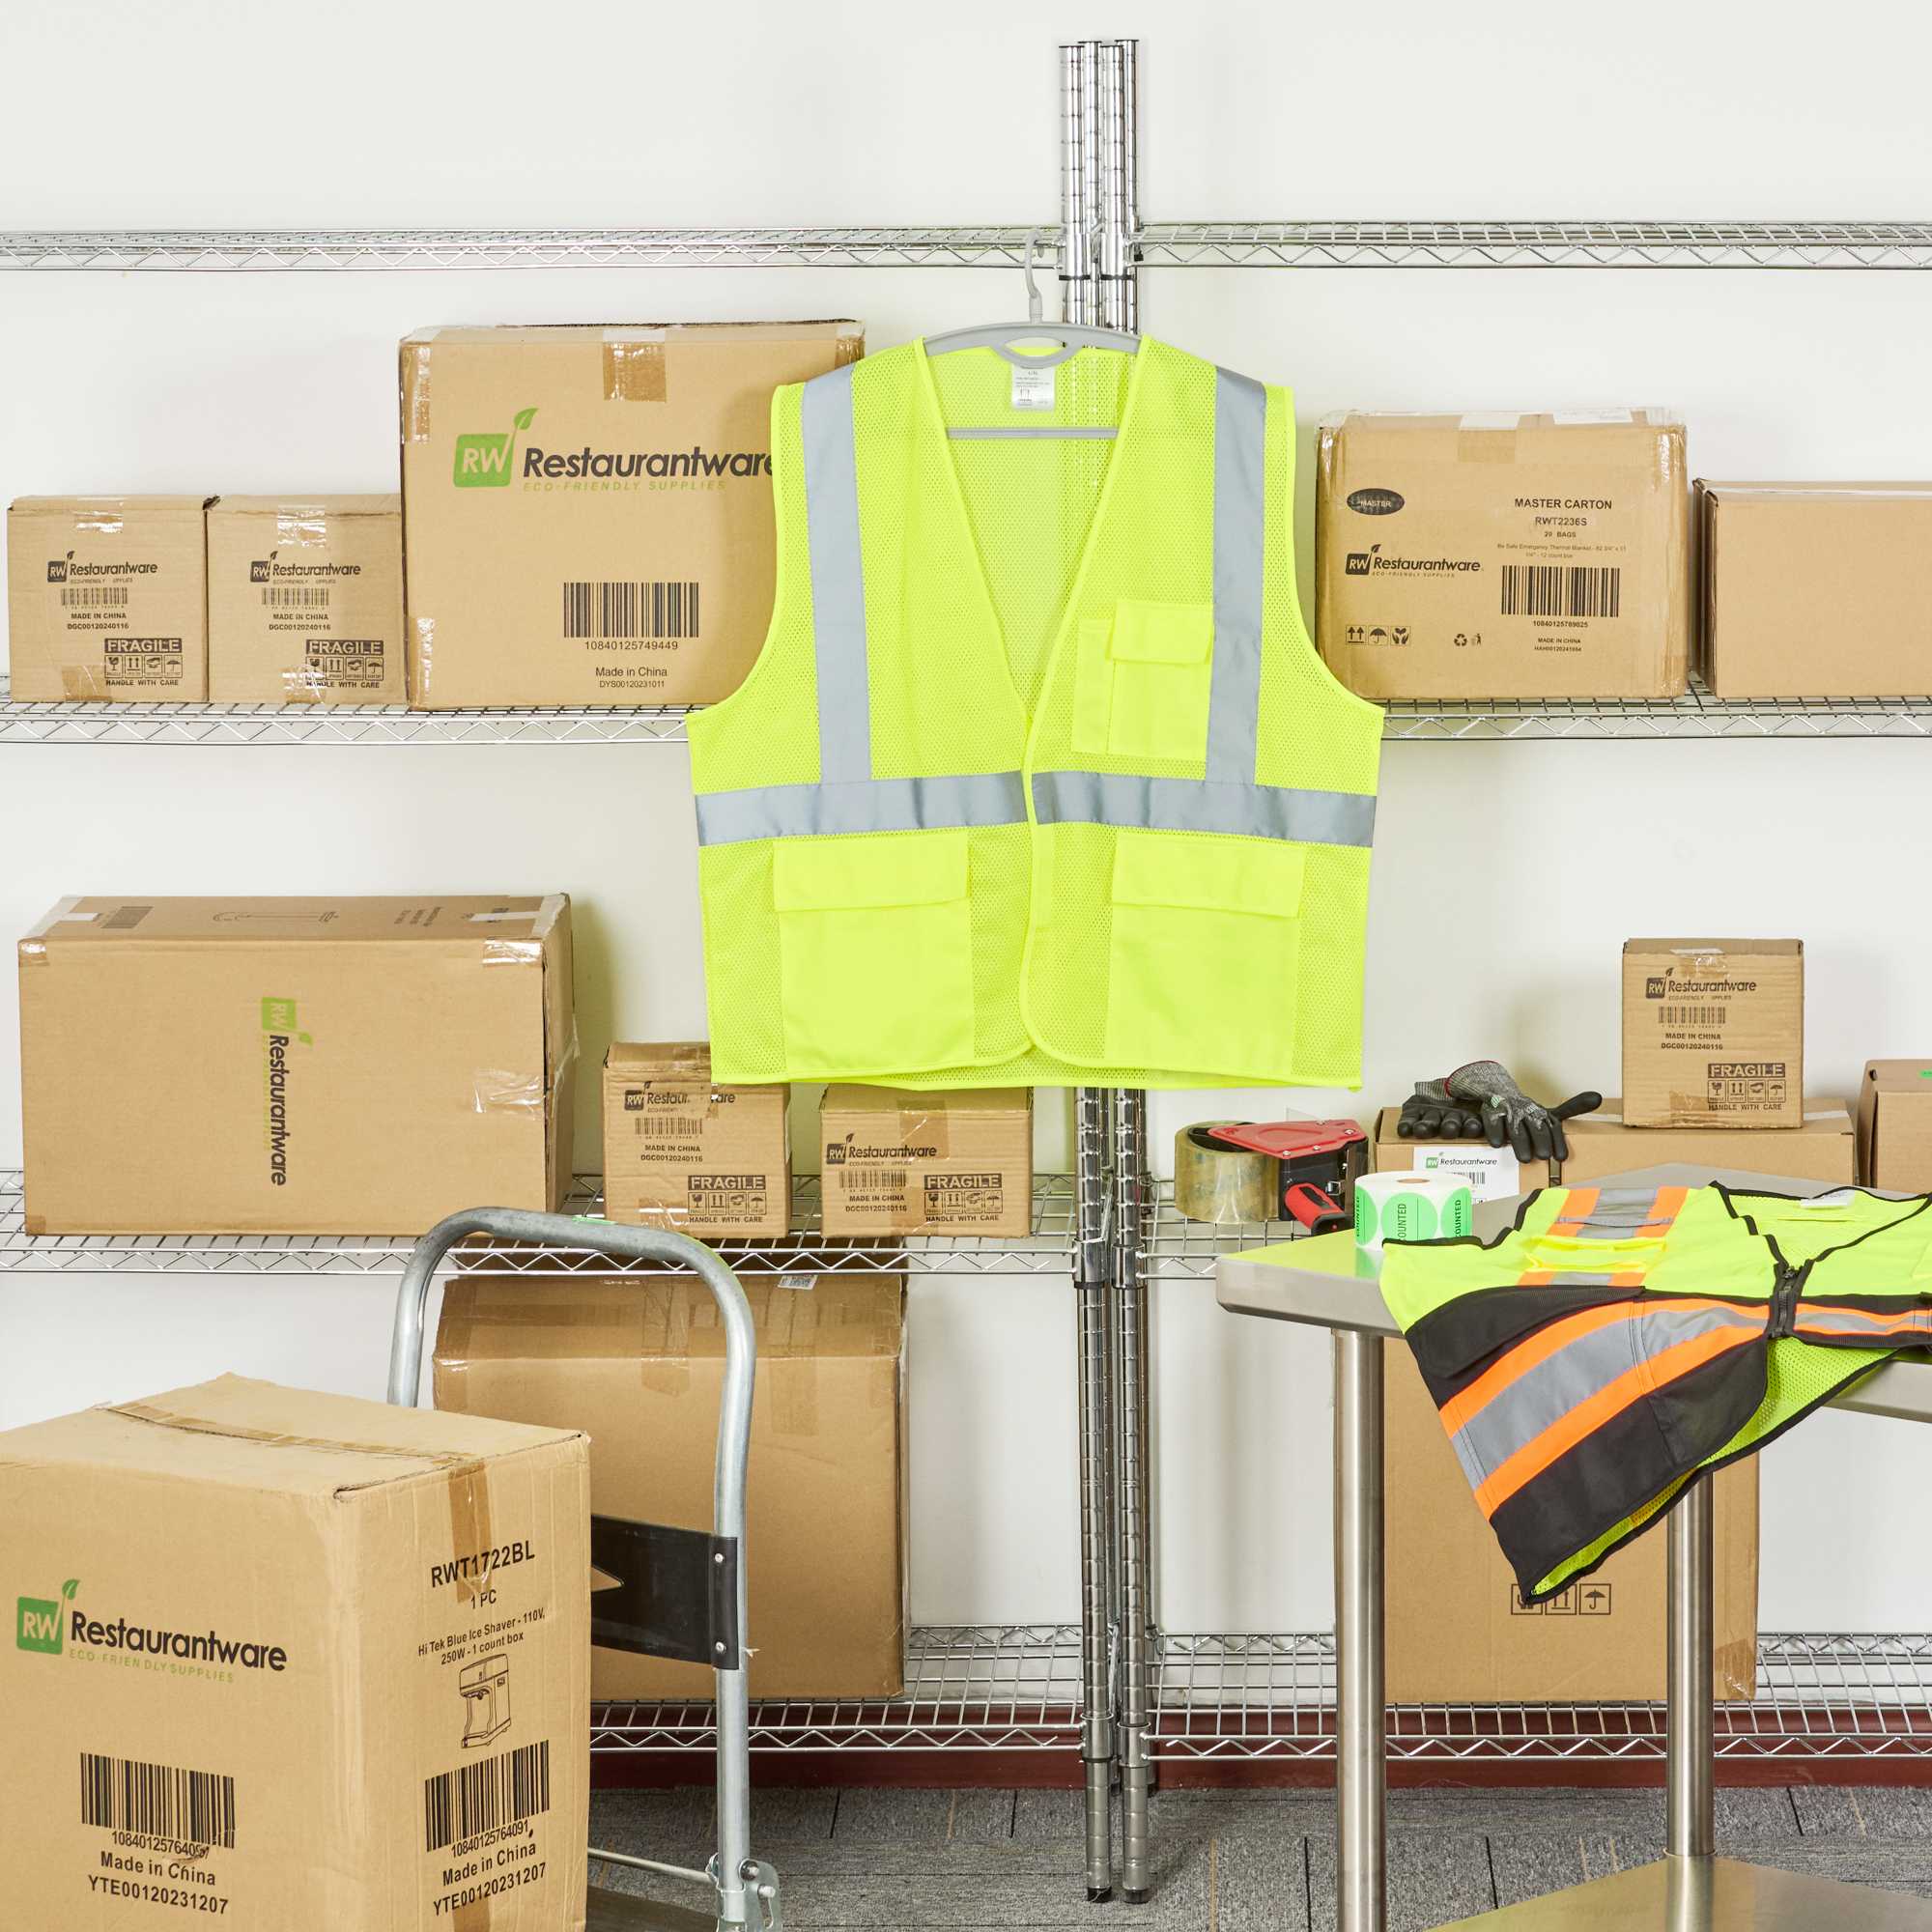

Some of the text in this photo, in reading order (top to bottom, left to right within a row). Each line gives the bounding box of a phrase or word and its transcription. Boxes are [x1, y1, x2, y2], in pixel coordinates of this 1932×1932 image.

[463, 447, 507, 473] RW
[648, 480, 726, 491] SUPPLIES
[1360, 499, 1392, 508] MASTER
[1514, 498, 1612, 509] MASTER CARTON
[1535, 517, 1588, 526] RWT2236S
[70, 561, 158, 576] Restaurantware
[272, 562, 361, 576] Restaurantware
[1350, 556, 1481, 571] RW Restaurantware
[107, 639, 180, 652] FRAGILE
[309, 640, 382, 654] FRAGILE
[585, 641, 678, 650] 10840125749449
[596, 667, 668, 676] Made in China
[1668, 979, 1757, 992] Restaurantware
[1711, 1065, 1783, 1077] FRAGILE
[647, 1092, 735, 1104] Restaurare
[269, 1035, 291, 1186] Restaurantware
[848, 1145, 937, 1158] Restaurantware
[691, 1177, 764, 1189] FRAGILE
[927, 1175, 1000, 1188] FRAGILE
[431, 1540, 535, 1588] RWT1722BL
[470, 1589, 497, 1609] 1 PC
[23, 1610, 287, 1671] RW Restaurantware
[418, 1644, 428, 1657] Hi
[429, 1639, 445, 1652] Tek
[447, 1633, 467, 1648] Blue
[469, 1629, 482, 1640] Ice
[484, 1618, 516, 1635] Shaver
[441, 1647, 466, 1665] 250W
[472, 1644, 476, 1654] 1
[479, 1635, 505, 1653] count
[507, 1631, 524, 1644] box
[170, 1663, 235, 1683] SUPPLIES
[451, 1819, 529, 1859] 10840125764091
[100, 1851, 215, 1886] Made in China
[442, 1843, 536, 1887] Made in China
[88, 1874, 229, 1915] YTE00120231207
[433, 1861, 546, 1917] YTE00120231207
